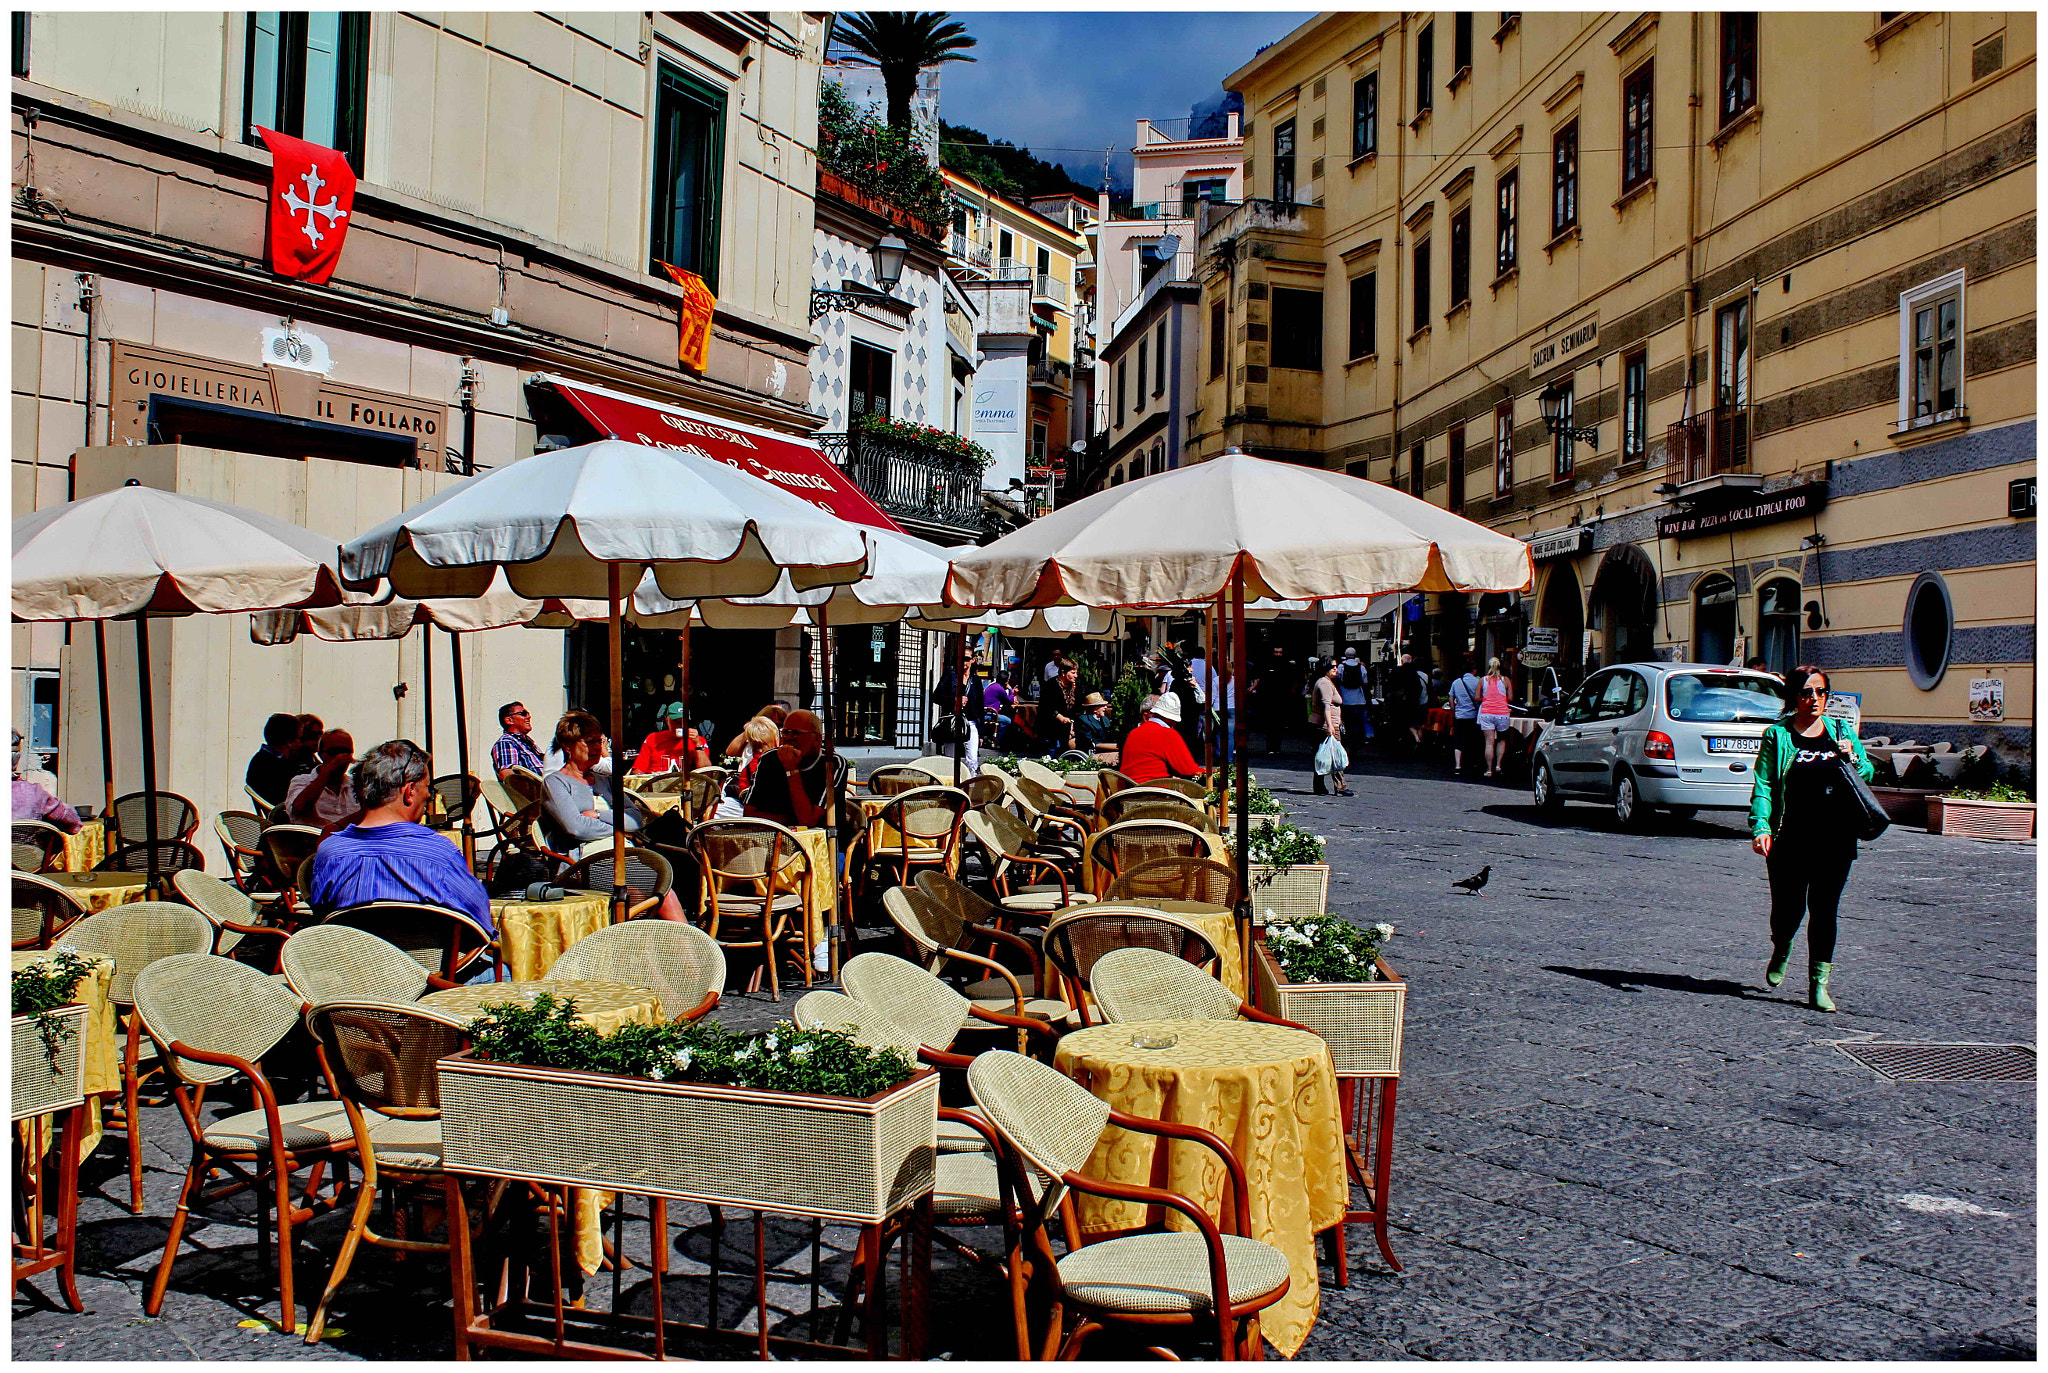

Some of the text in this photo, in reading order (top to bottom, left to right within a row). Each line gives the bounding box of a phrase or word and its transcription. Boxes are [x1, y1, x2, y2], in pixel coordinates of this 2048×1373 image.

[1533, 320, 1597, 369] SACRUM SEMINARIUM
[128, 368, 265, 406] GIOIELLERIA
[317, 400, 437, 435] IL FOLLARO
[660, 413, 758, 450] OREFICERIA
[974, 409, 1016, 419] emma
[1664, 521, 1680, 534] WINE
[1682, 519, 1696, 531] BAR
[1700, 515, 1718, 528] PIZZA
[1729, 506, 1753, 521] LOCAL
[1755, 500, 1783, 517] TYPICAL
[1785, 495, 1806, 510] FOOD
